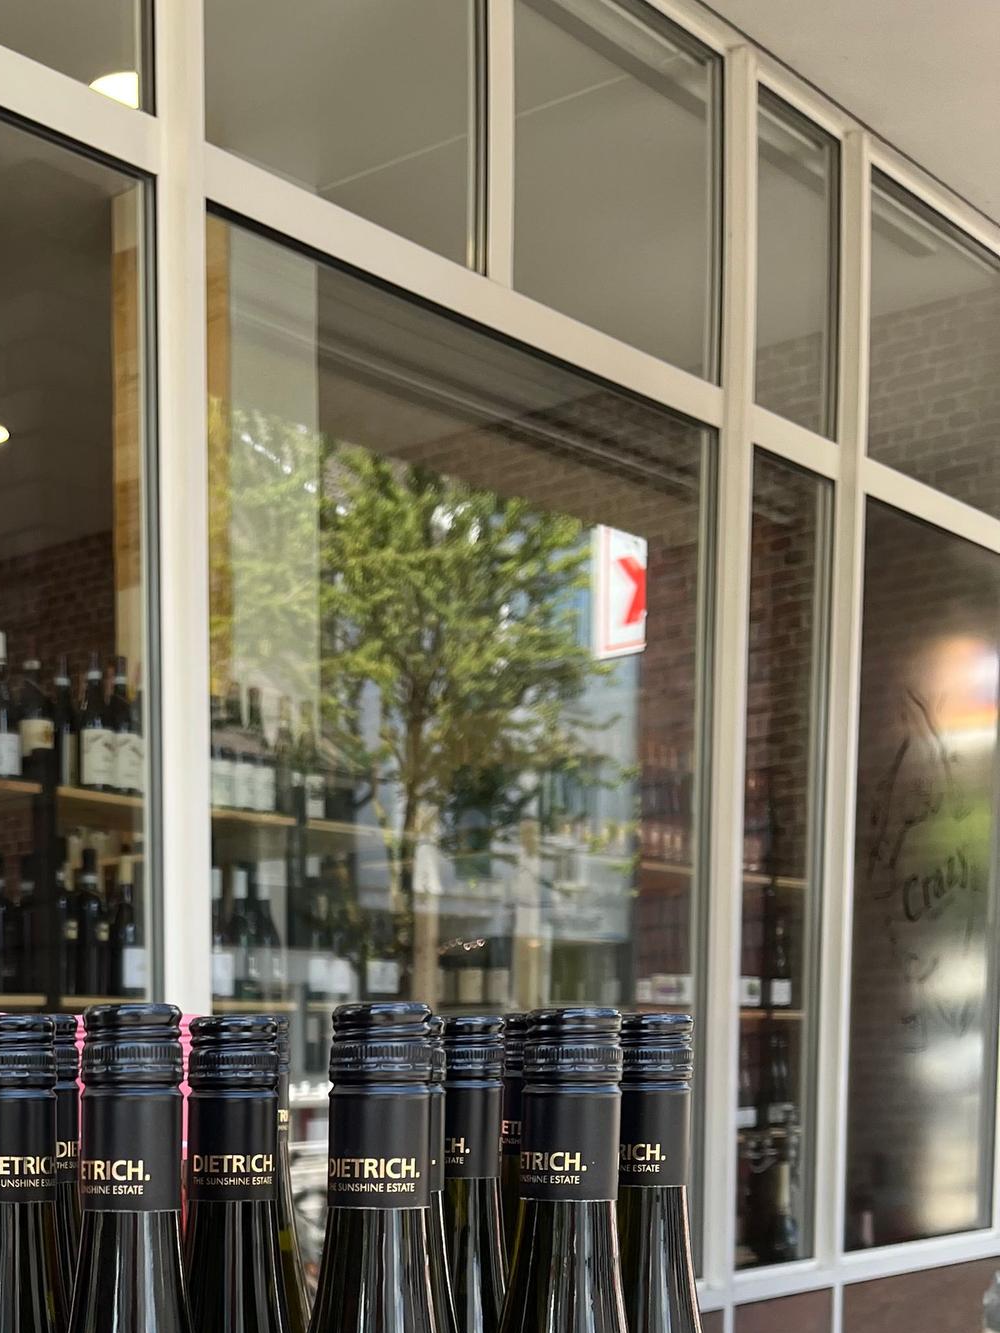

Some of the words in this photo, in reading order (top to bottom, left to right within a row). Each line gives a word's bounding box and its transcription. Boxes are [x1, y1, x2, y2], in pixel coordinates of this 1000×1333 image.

[193, 1155, 276, 1173] DIETRICH.
[329, 1158, 421, 1178] DIETRICH.
[632, 1164, 660, 1173] ESTATE
[206, 1176, 250, 1186] SUNSHINE
[252, 1176, 273, 1186] ESTATE
[550, 1175, 580, 1185] ESTATE
[112, 1185, 144, 1195] ESTATE
[338, 1182, 384, 1192] SUNSHINE
[386, 1182, 415, 1193] ESTATE
